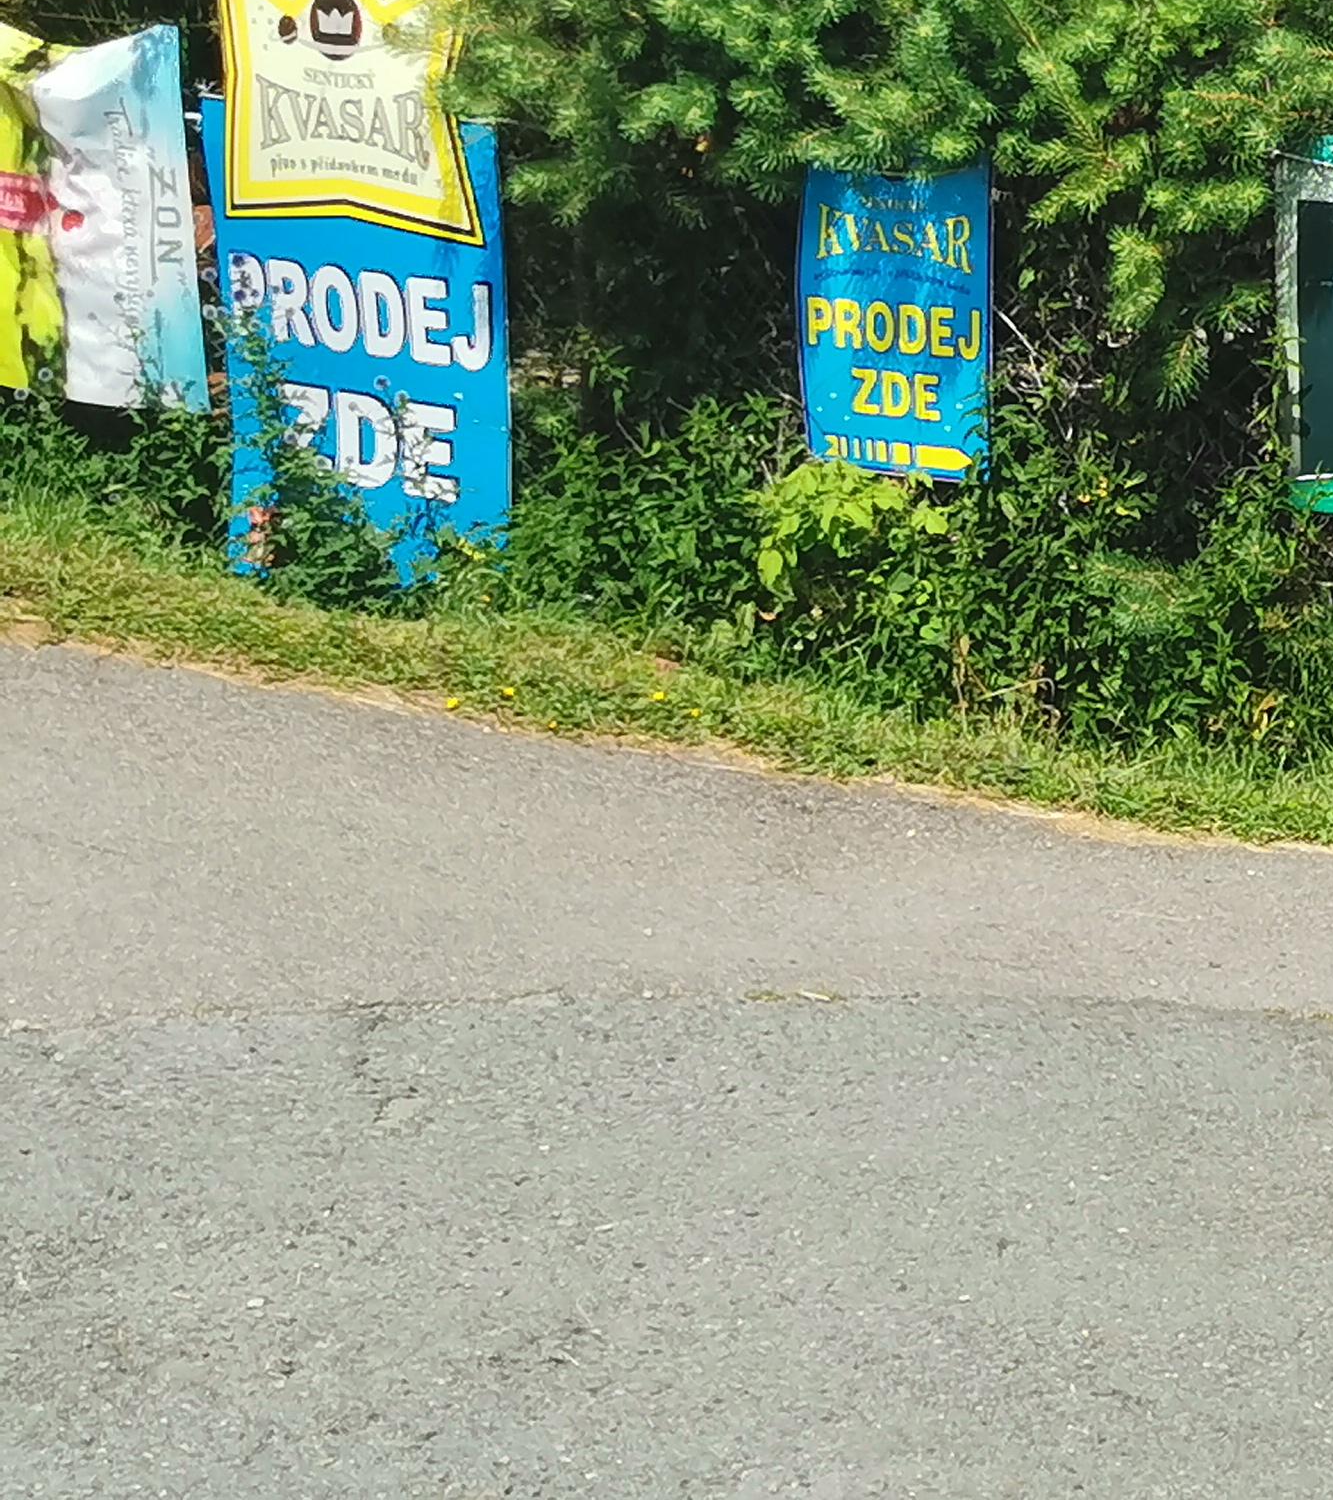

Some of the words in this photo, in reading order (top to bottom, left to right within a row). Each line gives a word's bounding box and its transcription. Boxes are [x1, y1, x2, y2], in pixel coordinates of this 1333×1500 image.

[255, 73, 431, 171] KVASAR
[382, 166, 419, 187] medu
[816, 202, 972, 275] KVASAR
[227, 250, 493, 372] PRODEJ
[807, 294, 982, 362] PRODEJ
[851, 368, 942, 424] ZDE
[280, 382, 459, 503] ZDE
